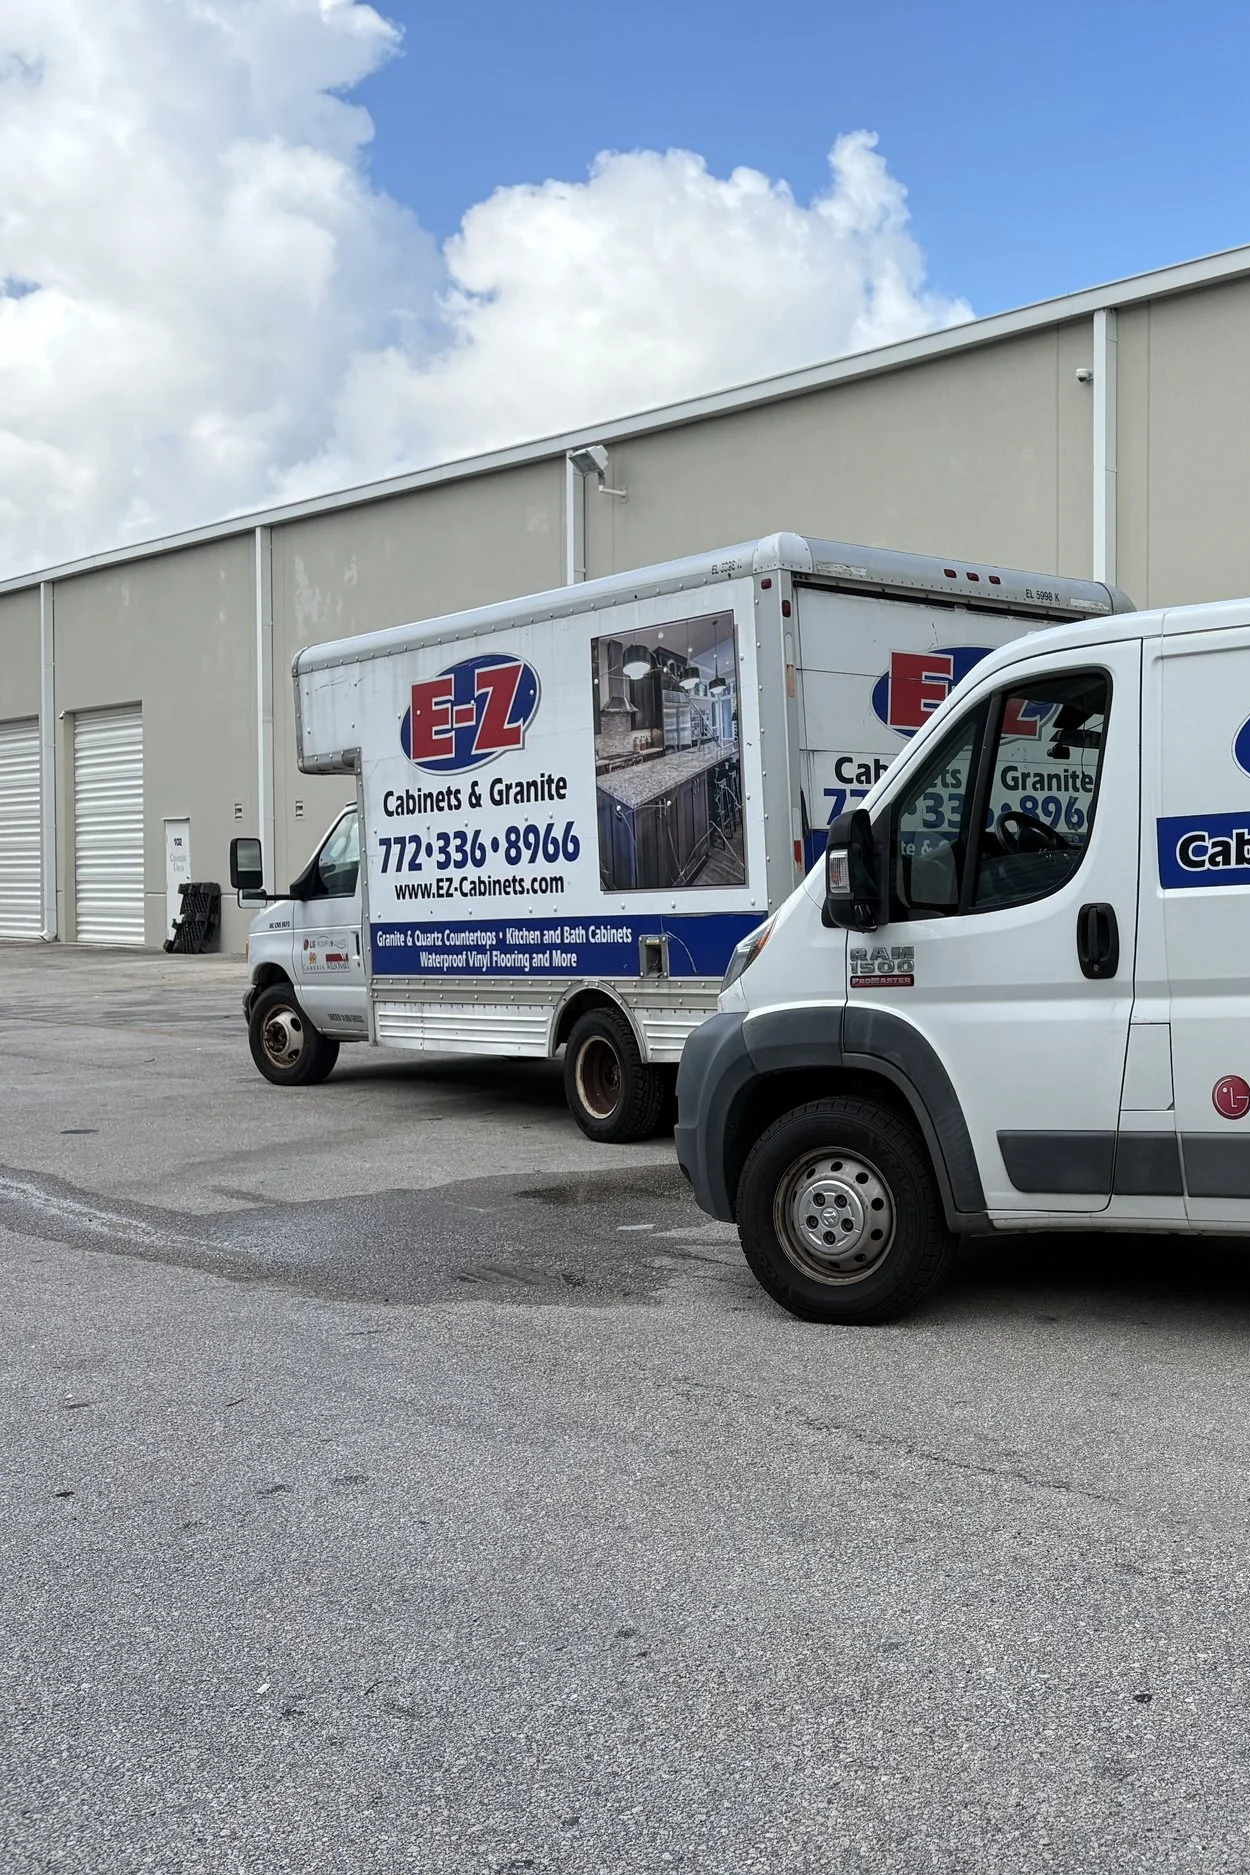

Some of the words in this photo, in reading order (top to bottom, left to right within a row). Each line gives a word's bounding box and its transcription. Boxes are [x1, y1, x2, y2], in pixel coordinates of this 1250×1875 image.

[1025, 589, 1034, 599] EL
[1036, 591, 1053, 602] 5998
[1054, 593, 1060, 603] K
[410, 661, 525, 764] E-Z
[1001, 766, 1094, 793] Granite
[383, 785, 461, 817] Cabinets
[468, 781, 482, 808] &
[489, 773, 567, 806] Granite
[395, 875, 565, 900] www.EZ-Cabinets.com
[377, 931, 404, 947] Granite
[407, 931, 413, 947] &
[414, 930, 442, 947] Quartz
[443, 930, 496, 949] Countertops
[506, 927, 541, 945] Kitchen
[543, 927, 561, 944] and
[563, 926, 586, 944] Bath
[588, 925, 632, 944] Cabinets
[420, 951, 467, 971] Waterproof
[468, 950, 490, 970] Vinyl
[493, 950, 529, 972] Flooring
[532, 950, 550, 968] and
[552, 951, 577, 968] More
[850, 946, 914, 962] RAM
[850, 960, 914, 974] 1500
